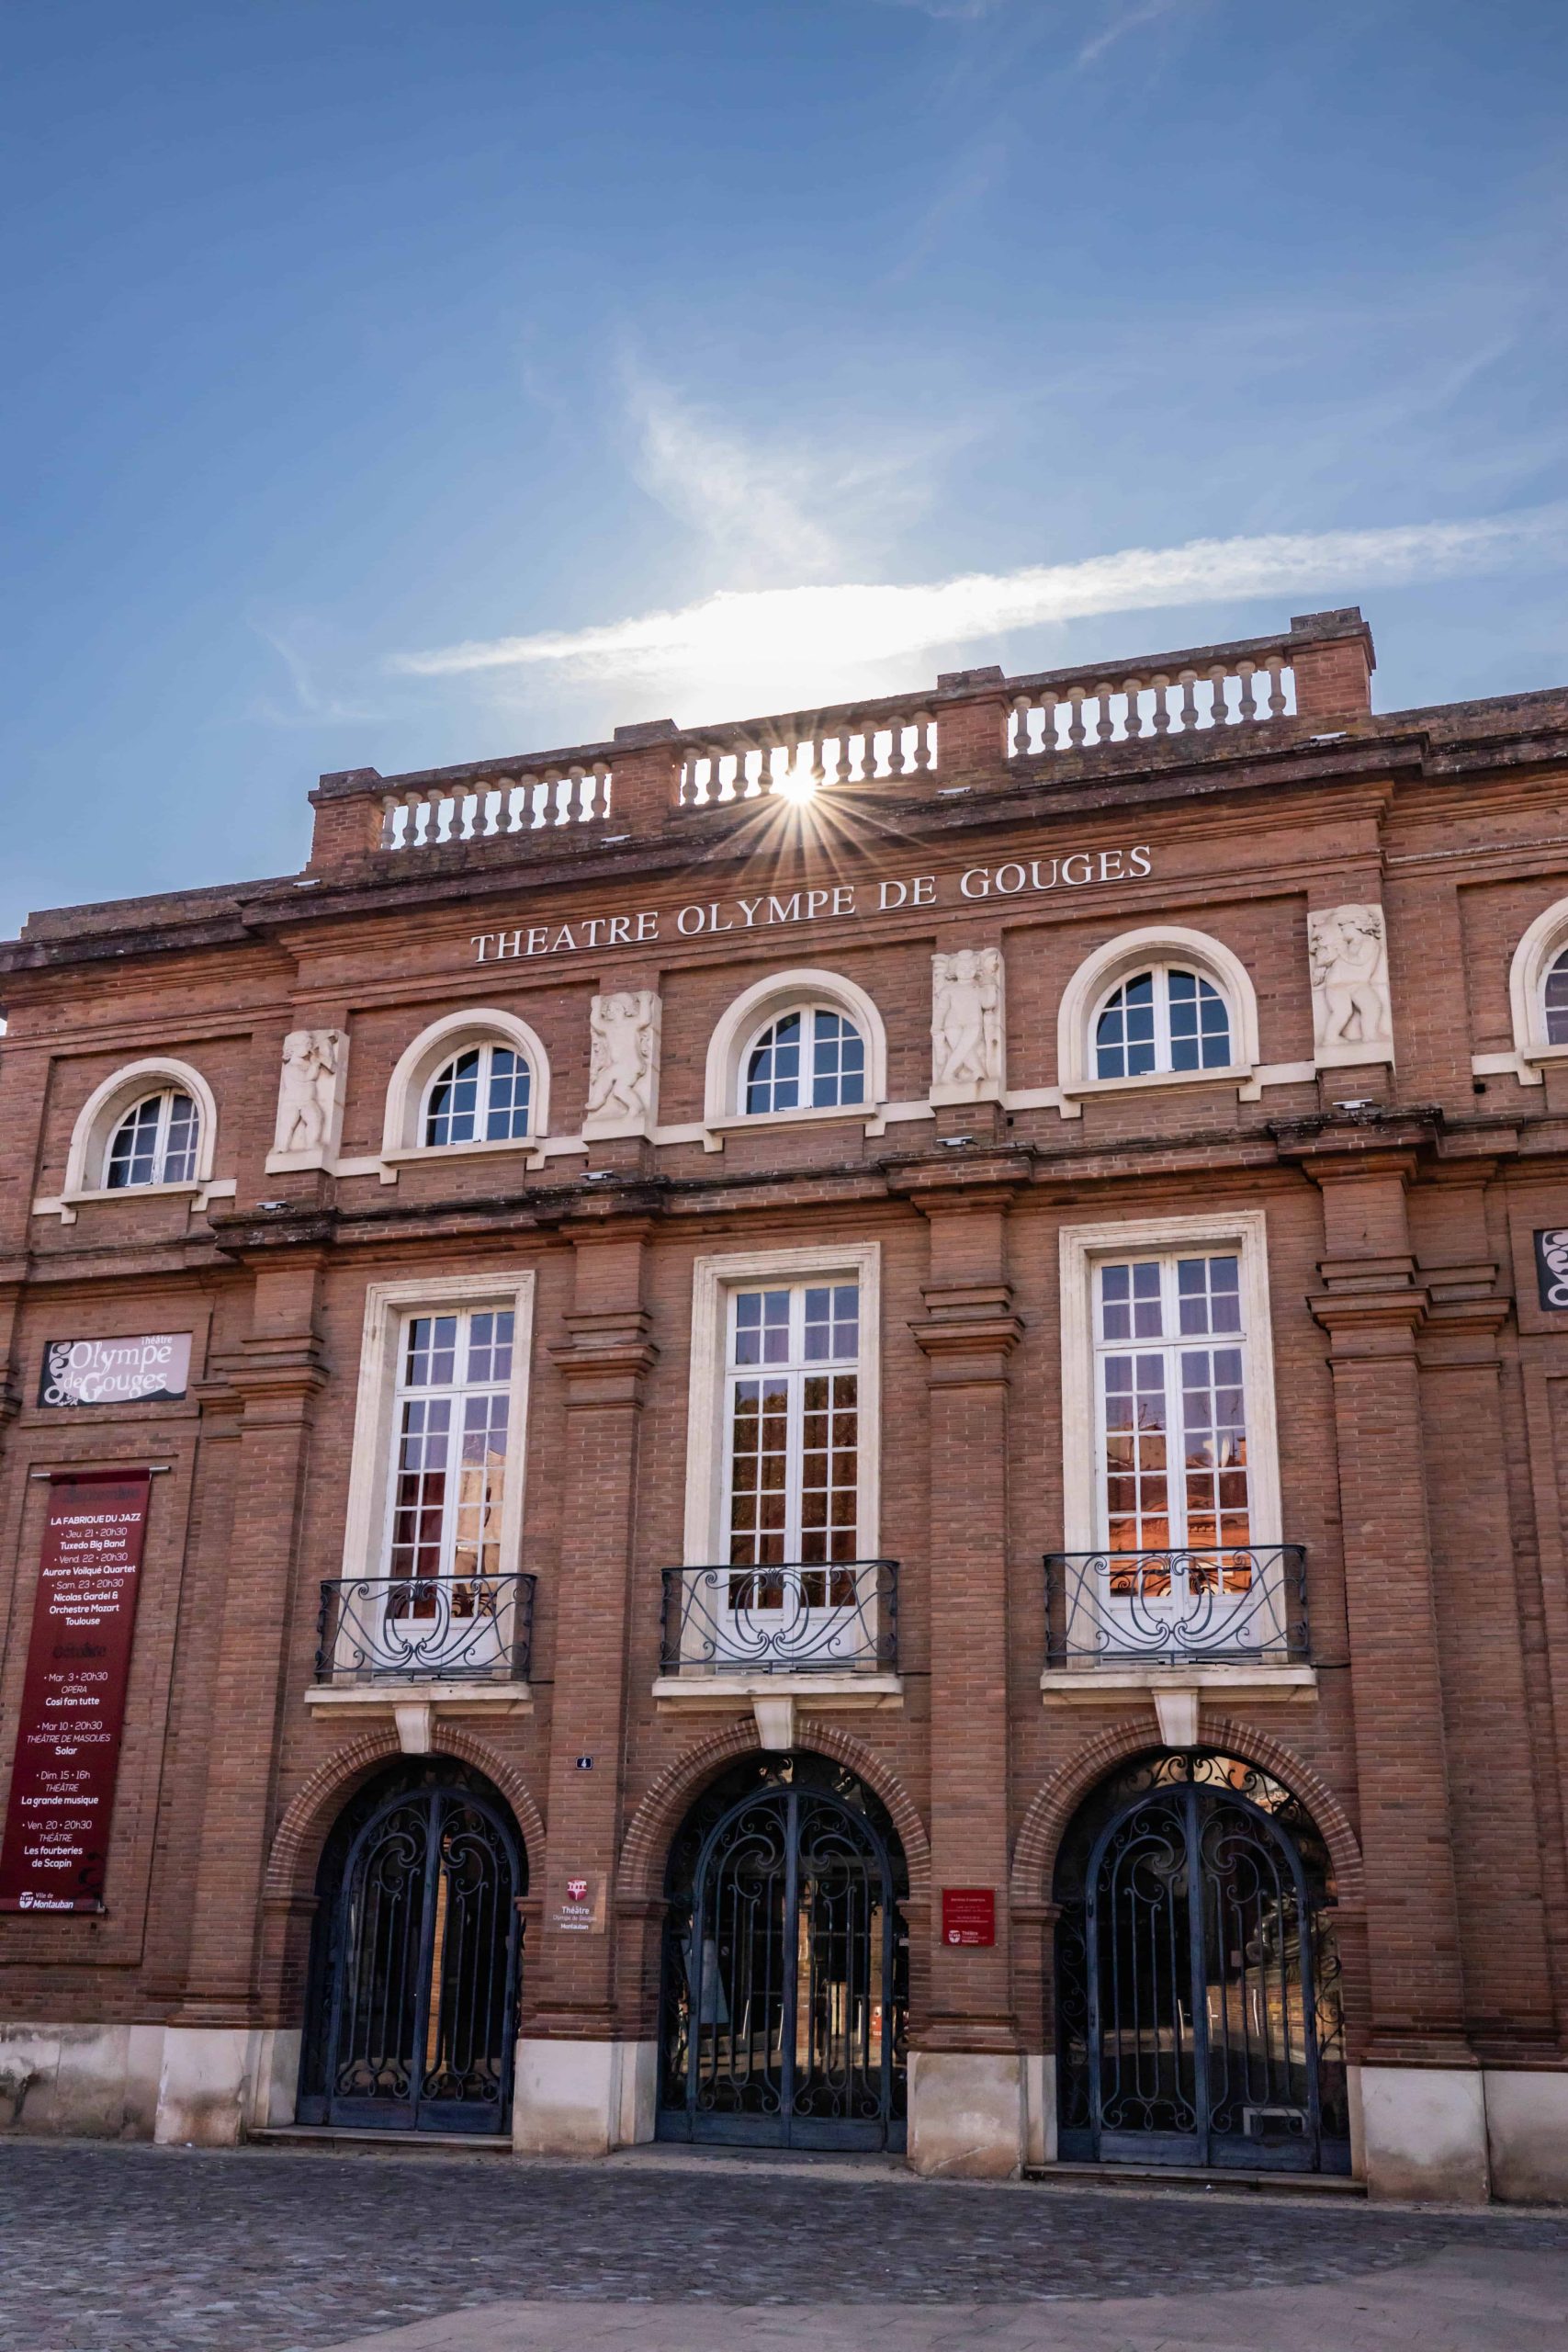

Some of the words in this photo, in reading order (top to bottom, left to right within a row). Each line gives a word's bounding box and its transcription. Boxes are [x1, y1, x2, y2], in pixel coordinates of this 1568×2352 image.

[470, 910, 660, 963] THEATRE
[677, 886, 856, 936] OLYMPE
[877, 876, 937, 910] DE
[960, 845, 1152, 899] GOUGES
[141, 1335, 173, 1346] Théâtre
[70, 1341, 173, 1375] Olympe
[63, 1372, 83, 1389] de
[79, 1372, 167, 1402] Gouges
[51, 1517, 62, 1525] LA
[63, 1515, 105, 1525] FABRIQUE
[106, 1514, 118, 1523] DU
[118, 1513, 141, 1522] JAZZ
[85, 1529, 94, 1538] 21
[100, 1527, 128, 1537] 20h30
[60, 1541, 88, 1550] Tuxedo
[90, 1541, 102, 1551] Big
[104, 1539, 126, 1548] Band
[82, 1555, 94, 1563] 22
[101, 1552, 128, 1562] 20h30
[43, 1568, 71, 1577] Aurore
[73, 1566, 102, 1577] Voilqué
[103, 1566, 136, 1574] Quartet
[78, 1580, 90, 1589] 23
[96, 1578, 123, 1589] 20h30
[53, 1593, 82, 1601] Nicolas
[84, 1591, 110, 1600] Gardel
[50, 1605, 89, 1614] Orchestre
[91, 1604, 119, 1612] Mozart
[66, 1617, 100, 1625] Toulouse
[68, 1673, 74, 1681] 3
[81, 1672, 107, 1680] 20h30
[63, 1697, 78, 1705] fan
[80, 1697, 100, 1705] tutte
[59, 1722, 69, 1731] 10
[74, 1721, 103, 1730] 20h30
[61, 1735, 72, 1743] DE
[73, 1734, 111, 1742] MASQUES
[55, 1747, 77, 1755] Solar
[581, 1758, 587, 1768] 4
[60, 1770, 69, 1780] 15
[76, 1770, 90, 1780] 16h
[21, 1796, 32, 1805] La
[32, 1796, 63, 1808] grande
[63, 1796, 99, 1806] musique
[46, 1821, 58, 1829] 20
[63, 1820, 92, 1829] 20h30
[24, 1846, 39, 1855] Les
[40, 1846, 83, 1855] fourberies
[31, 1859, 43, 1868] de
[44, 1859, 72, 1870] Scapin
[33, 1899, 73, 1909] Montauban
[561, 1905, 590, 1915] Théâtre
